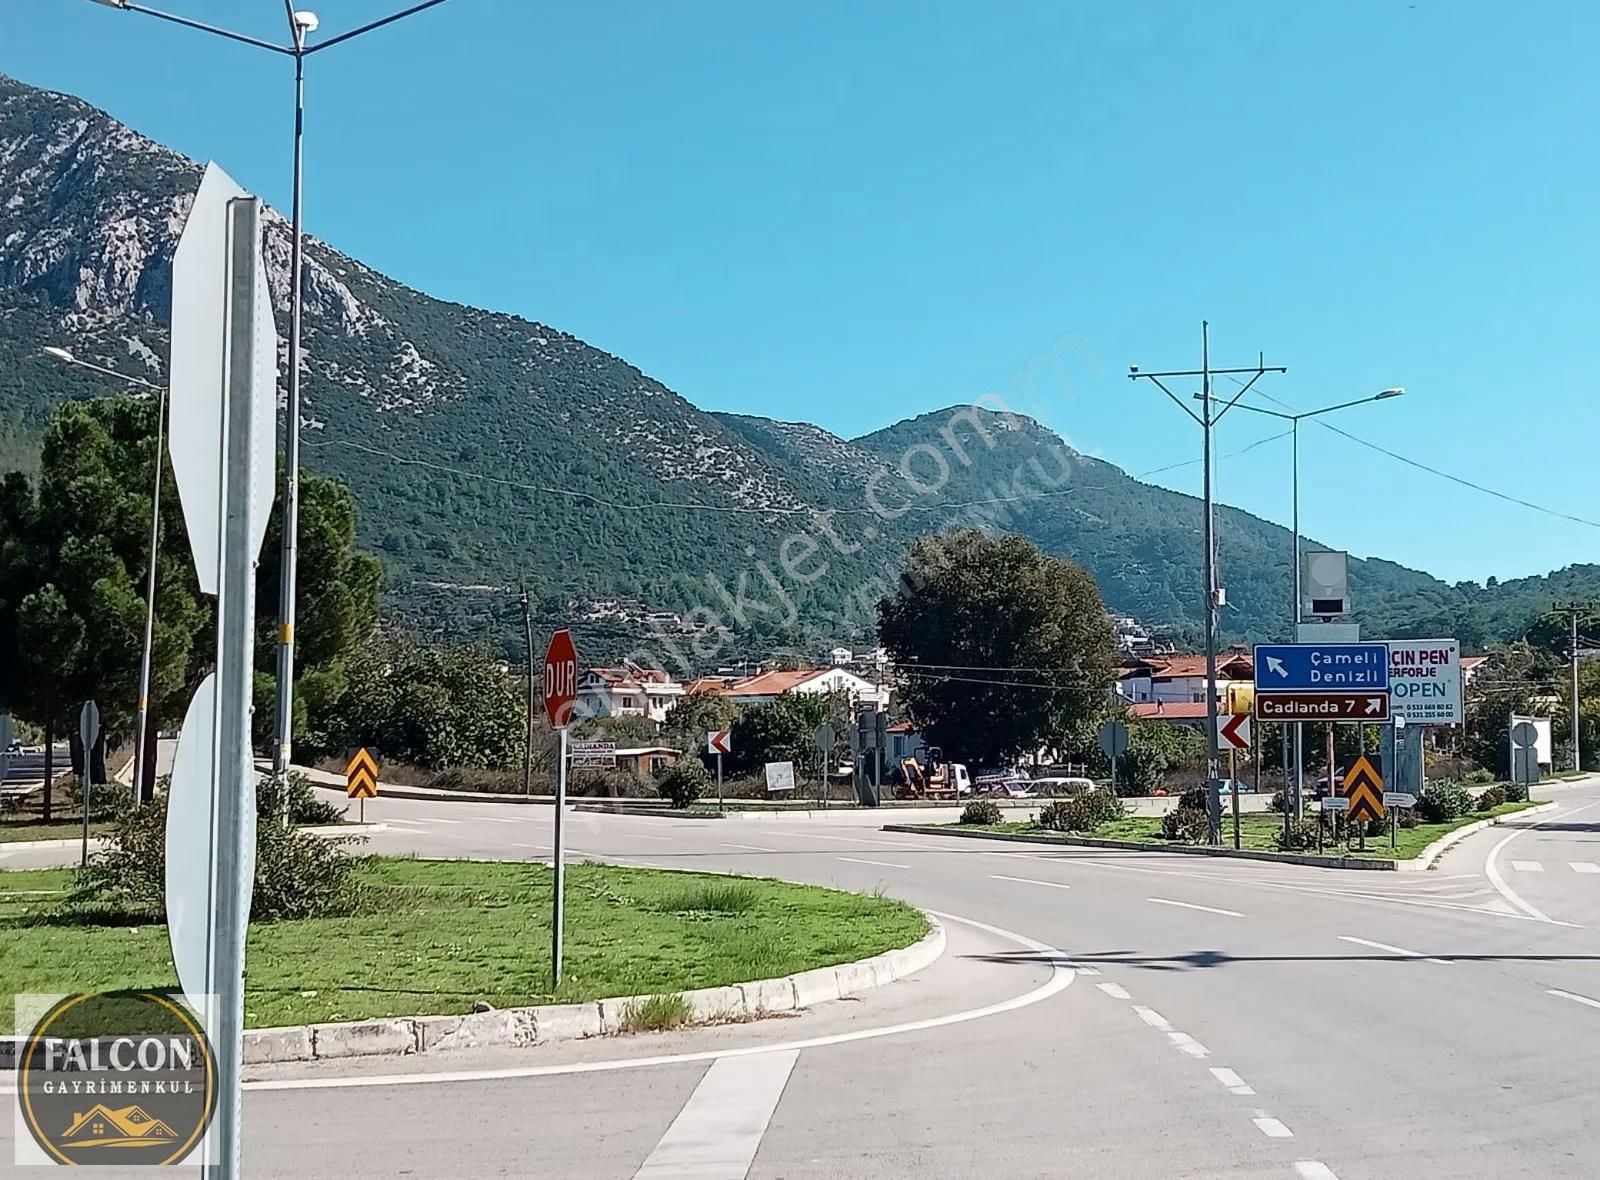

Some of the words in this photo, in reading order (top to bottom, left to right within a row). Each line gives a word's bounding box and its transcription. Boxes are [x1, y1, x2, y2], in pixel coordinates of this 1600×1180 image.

[1310, 652, 1377, 666] Çameli
[546, 660, 574, 698] DUR
[1310, 669, 1377, 682] Denizli
[1345, 700, 1356, 713] 7
